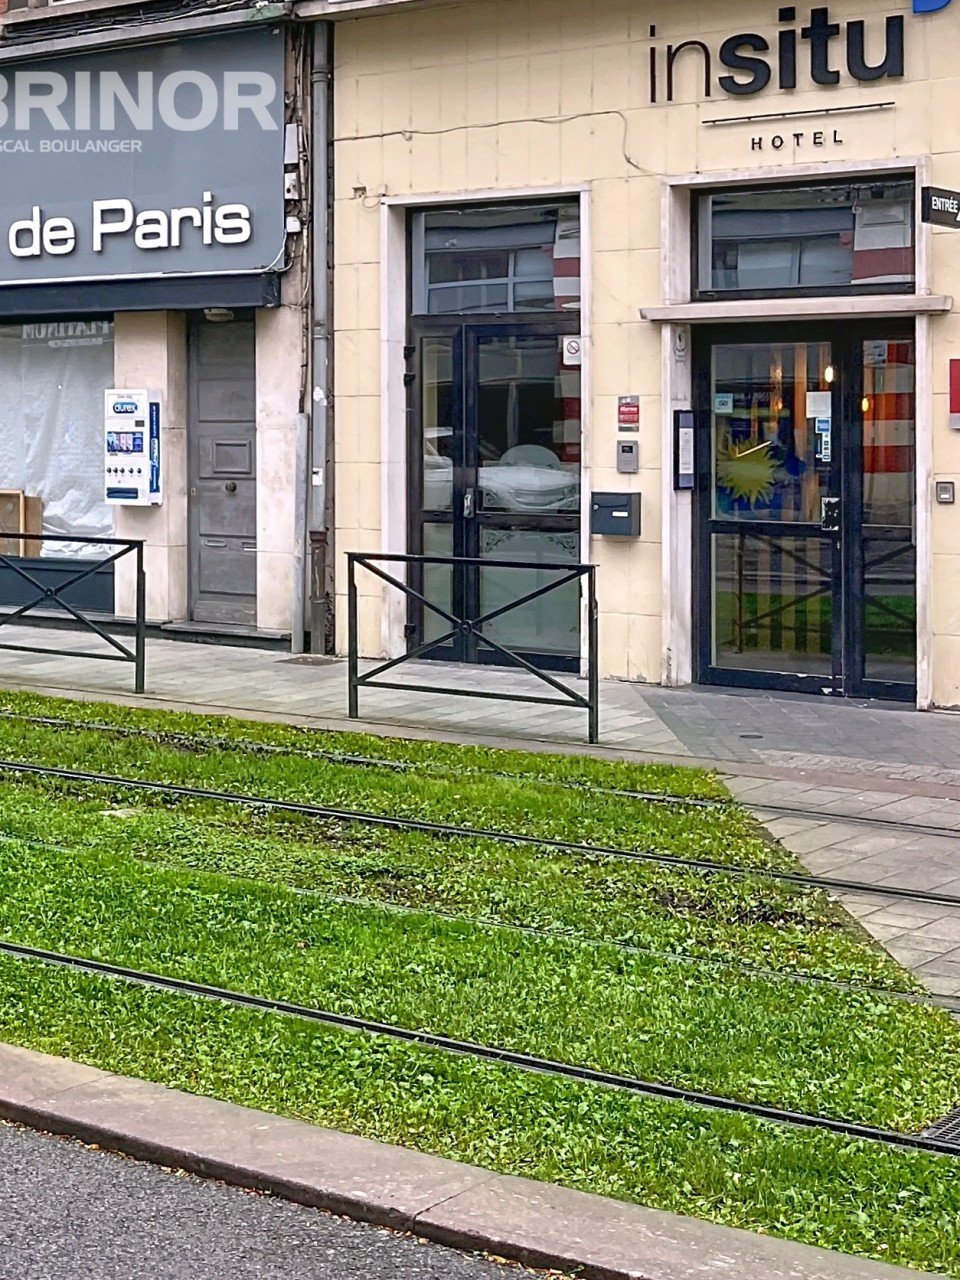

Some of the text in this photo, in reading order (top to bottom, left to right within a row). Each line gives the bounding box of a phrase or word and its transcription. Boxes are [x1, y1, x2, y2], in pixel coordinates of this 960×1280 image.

[649, 6, 905, 103] insitu
[751, 130, 843, 151] HOTEL
[8, 206, 76, 258] de
[92, 191, 252, 252] Paris
[931, 196, 958, 213] ENTRÉE
